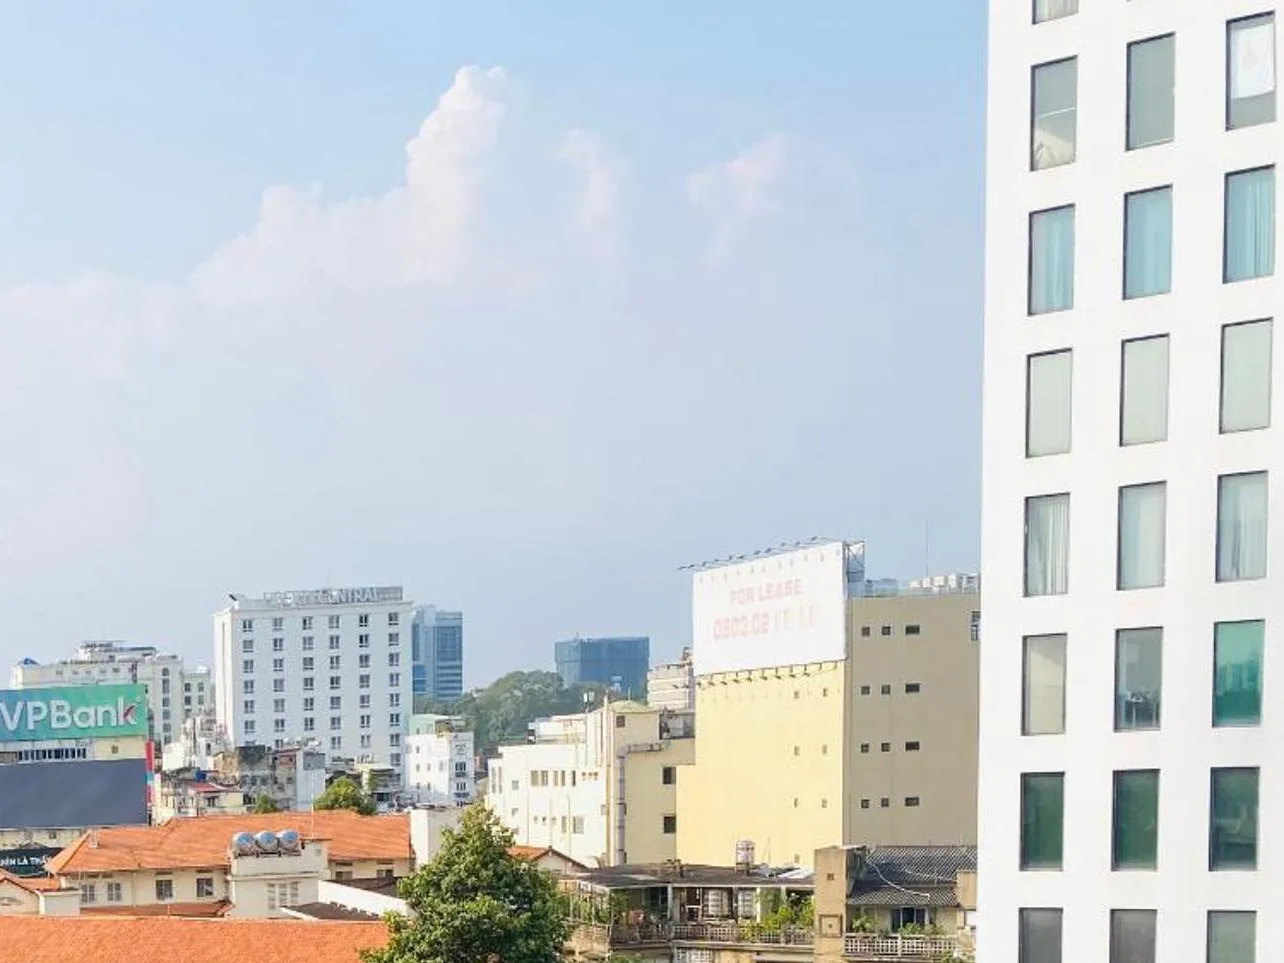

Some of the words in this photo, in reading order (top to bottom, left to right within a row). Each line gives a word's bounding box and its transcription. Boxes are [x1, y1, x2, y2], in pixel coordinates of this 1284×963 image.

[730, 586, 754, 605] FOR
[758, 578, 802, 602] LEASE
[0, 695, 138, 732] VPBank
